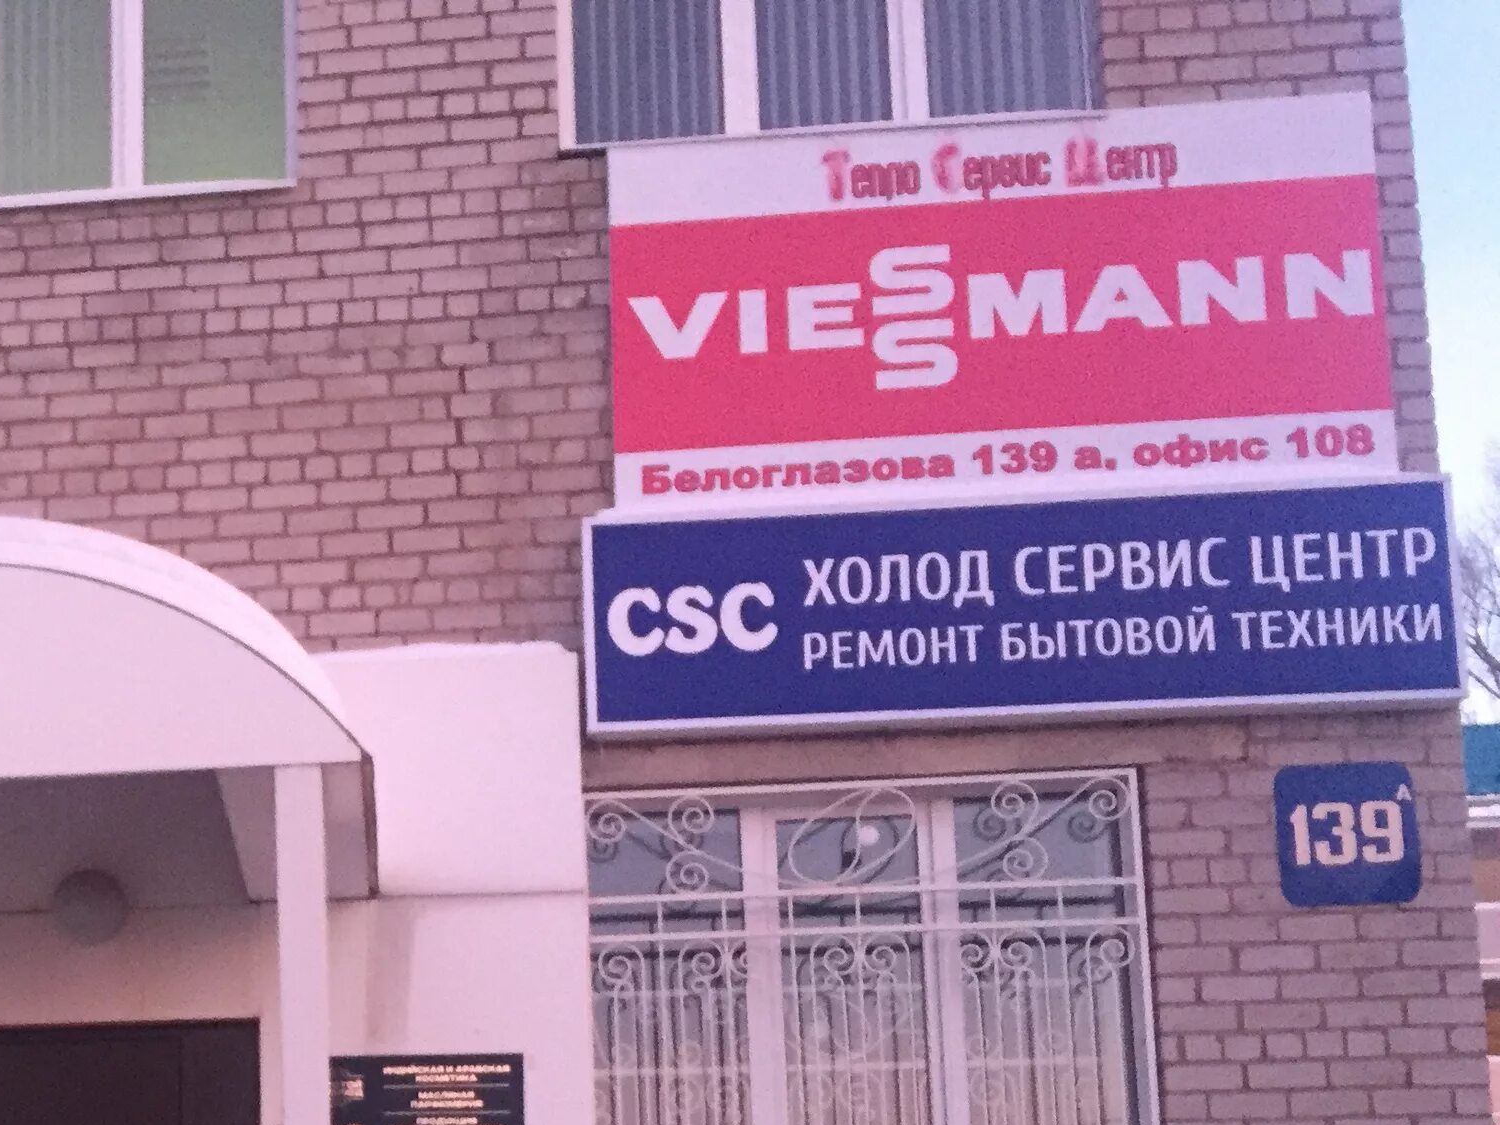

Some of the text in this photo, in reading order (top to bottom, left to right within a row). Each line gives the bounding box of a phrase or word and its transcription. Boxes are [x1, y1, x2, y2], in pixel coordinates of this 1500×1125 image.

[931, 143, 1051, 200] Сервис
[1066, 137, 1177, 191] Центр
[628, 243, 1376, 392] VIESSMANN
[641, 453, 956, 496] Белоглазова
[972, 440, 1058, 475] 139
[1133, 433, 1270, 468] офис
[1286, 423, 1376, 459] 108
[802, 526, 1437, 608] ХОЛОД СЕРВИС ЦЕНТР
[607, 581, 779, 657] CSC
[802, 602, 1443, 670] РЕМОНТ БЫТОВОЙ ТЕХНИКИ
[1289, 800, 1405, 866] 139
[415, 1073, 478, 1083] КОСМЕТИКА
